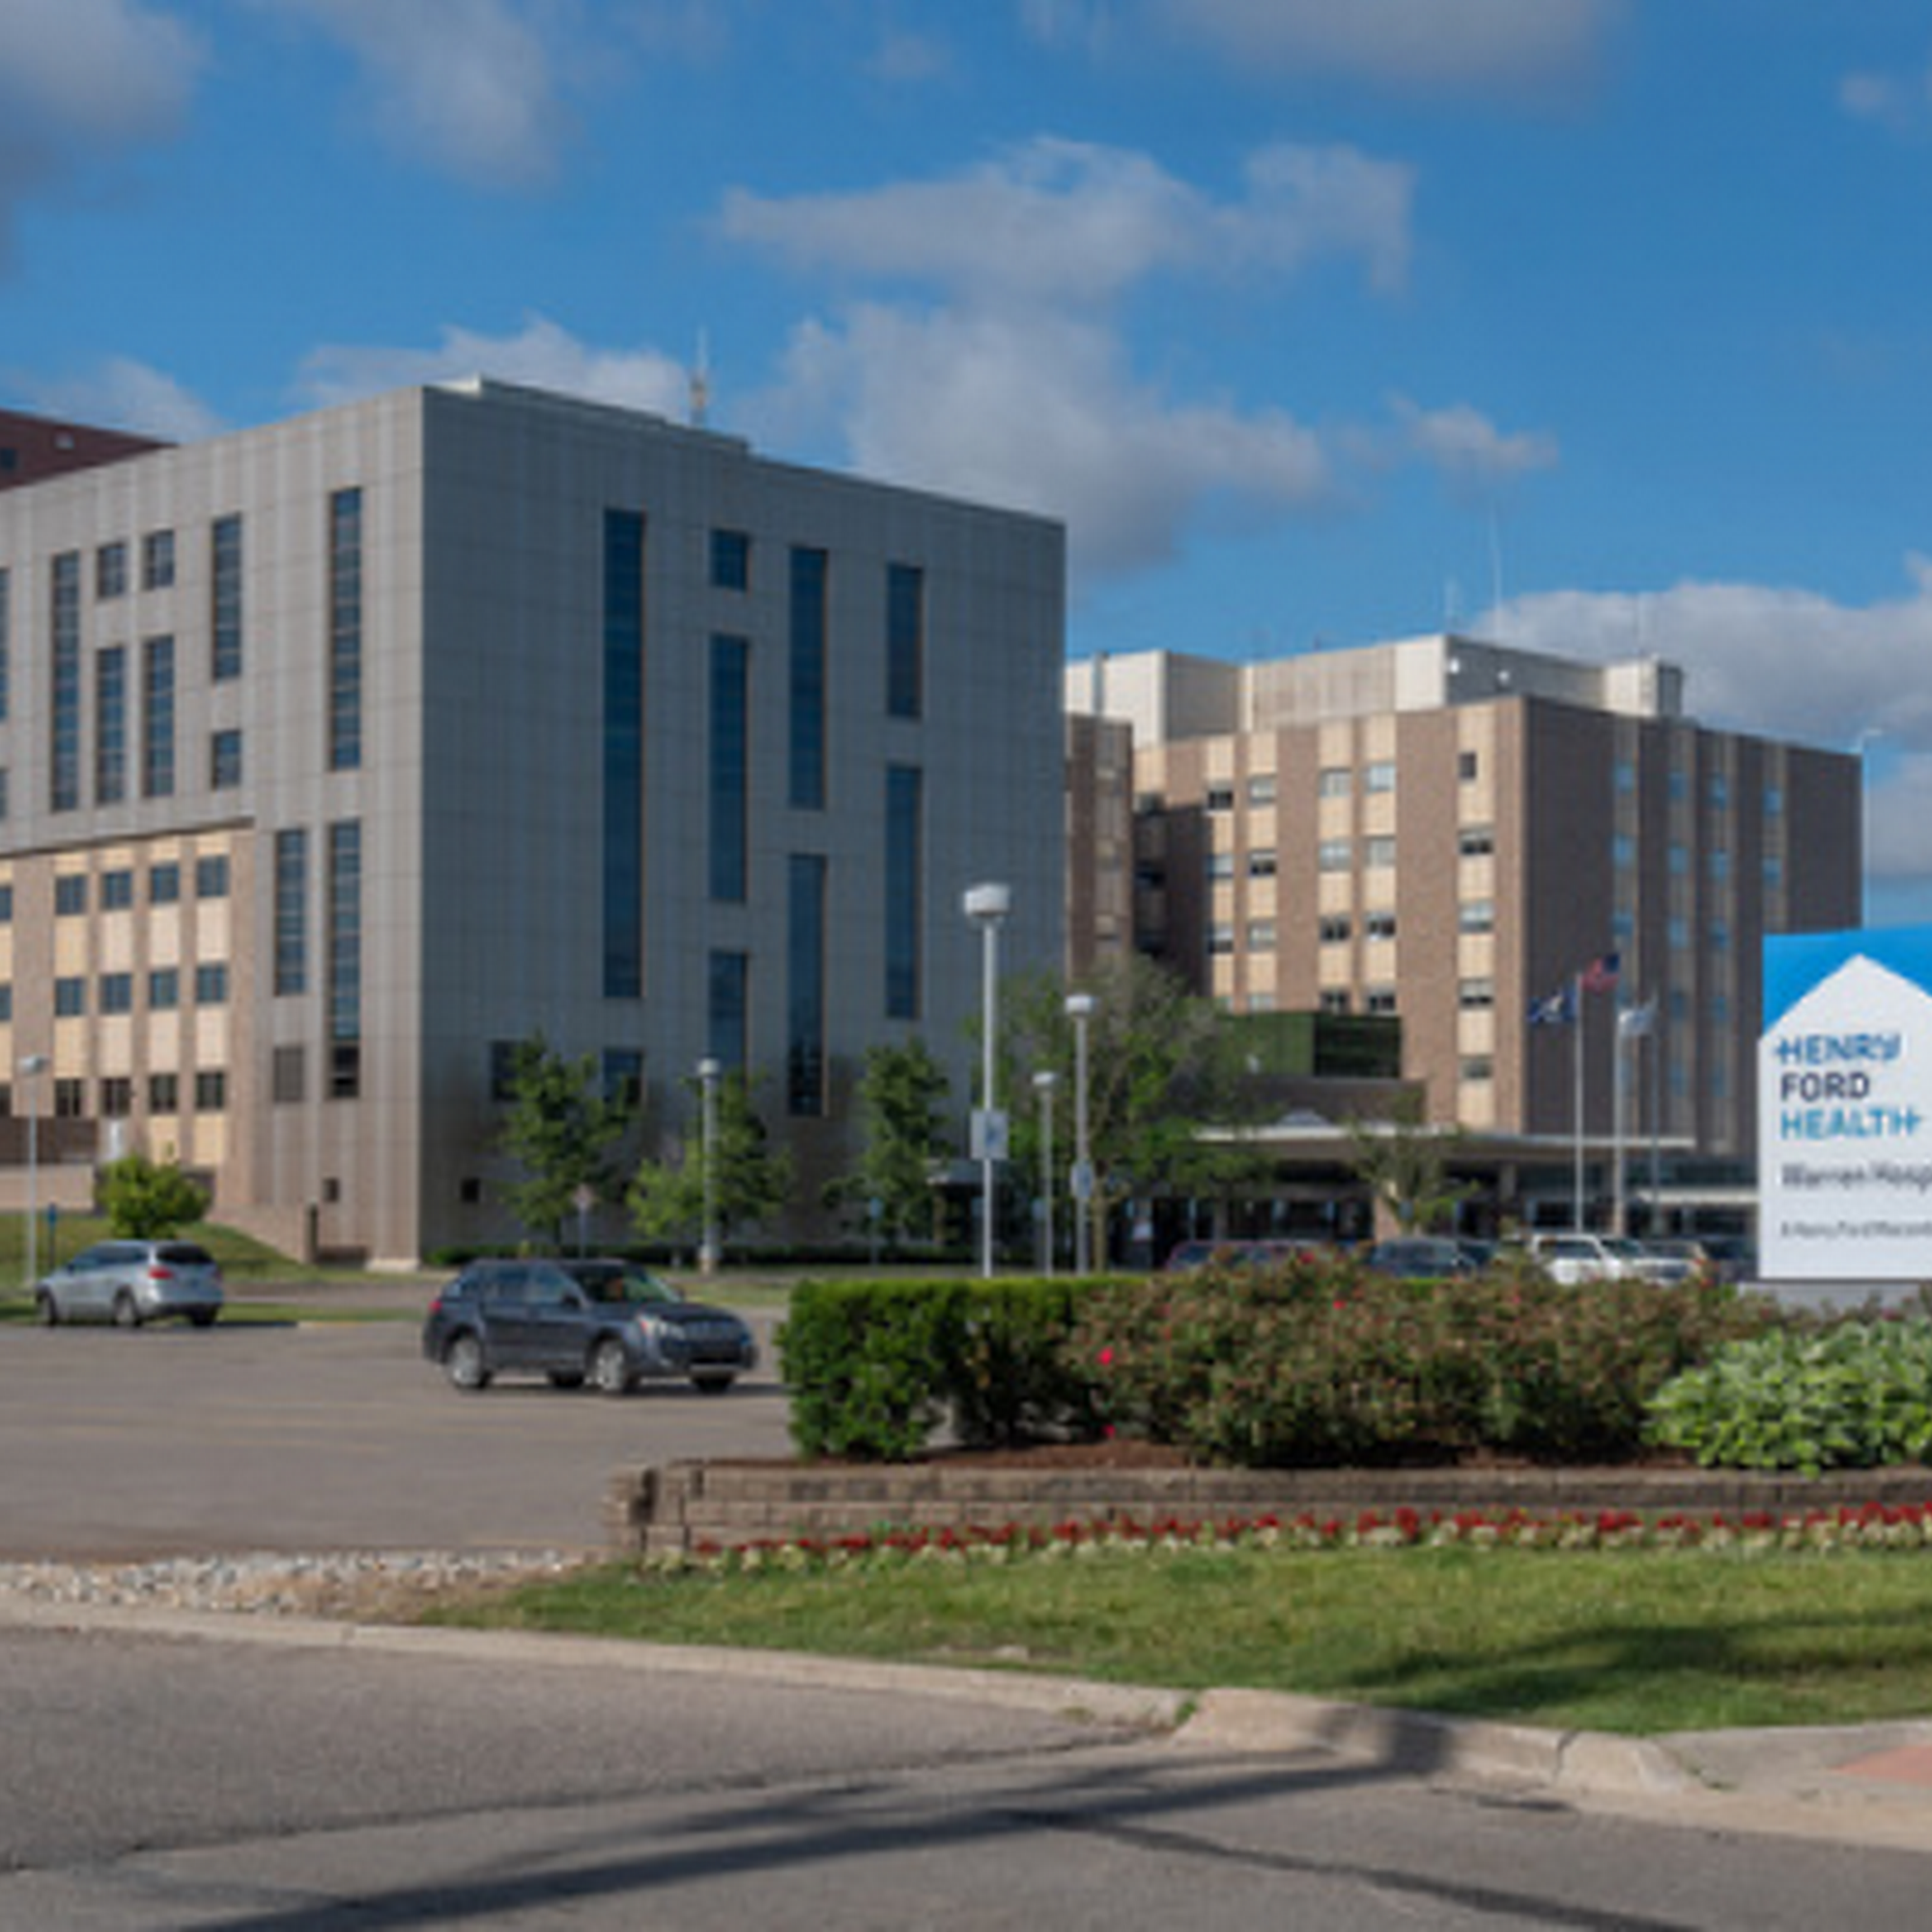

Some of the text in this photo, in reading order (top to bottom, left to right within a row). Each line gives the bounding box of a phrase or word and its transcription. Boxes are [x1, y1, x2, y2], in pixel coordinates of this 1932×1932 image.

[1776, 1033, 1901, 1065] HENRY
[1780, 1071, 1870, 1102] FORD
[1780, 1106, 1922, 1141] HEALTH
